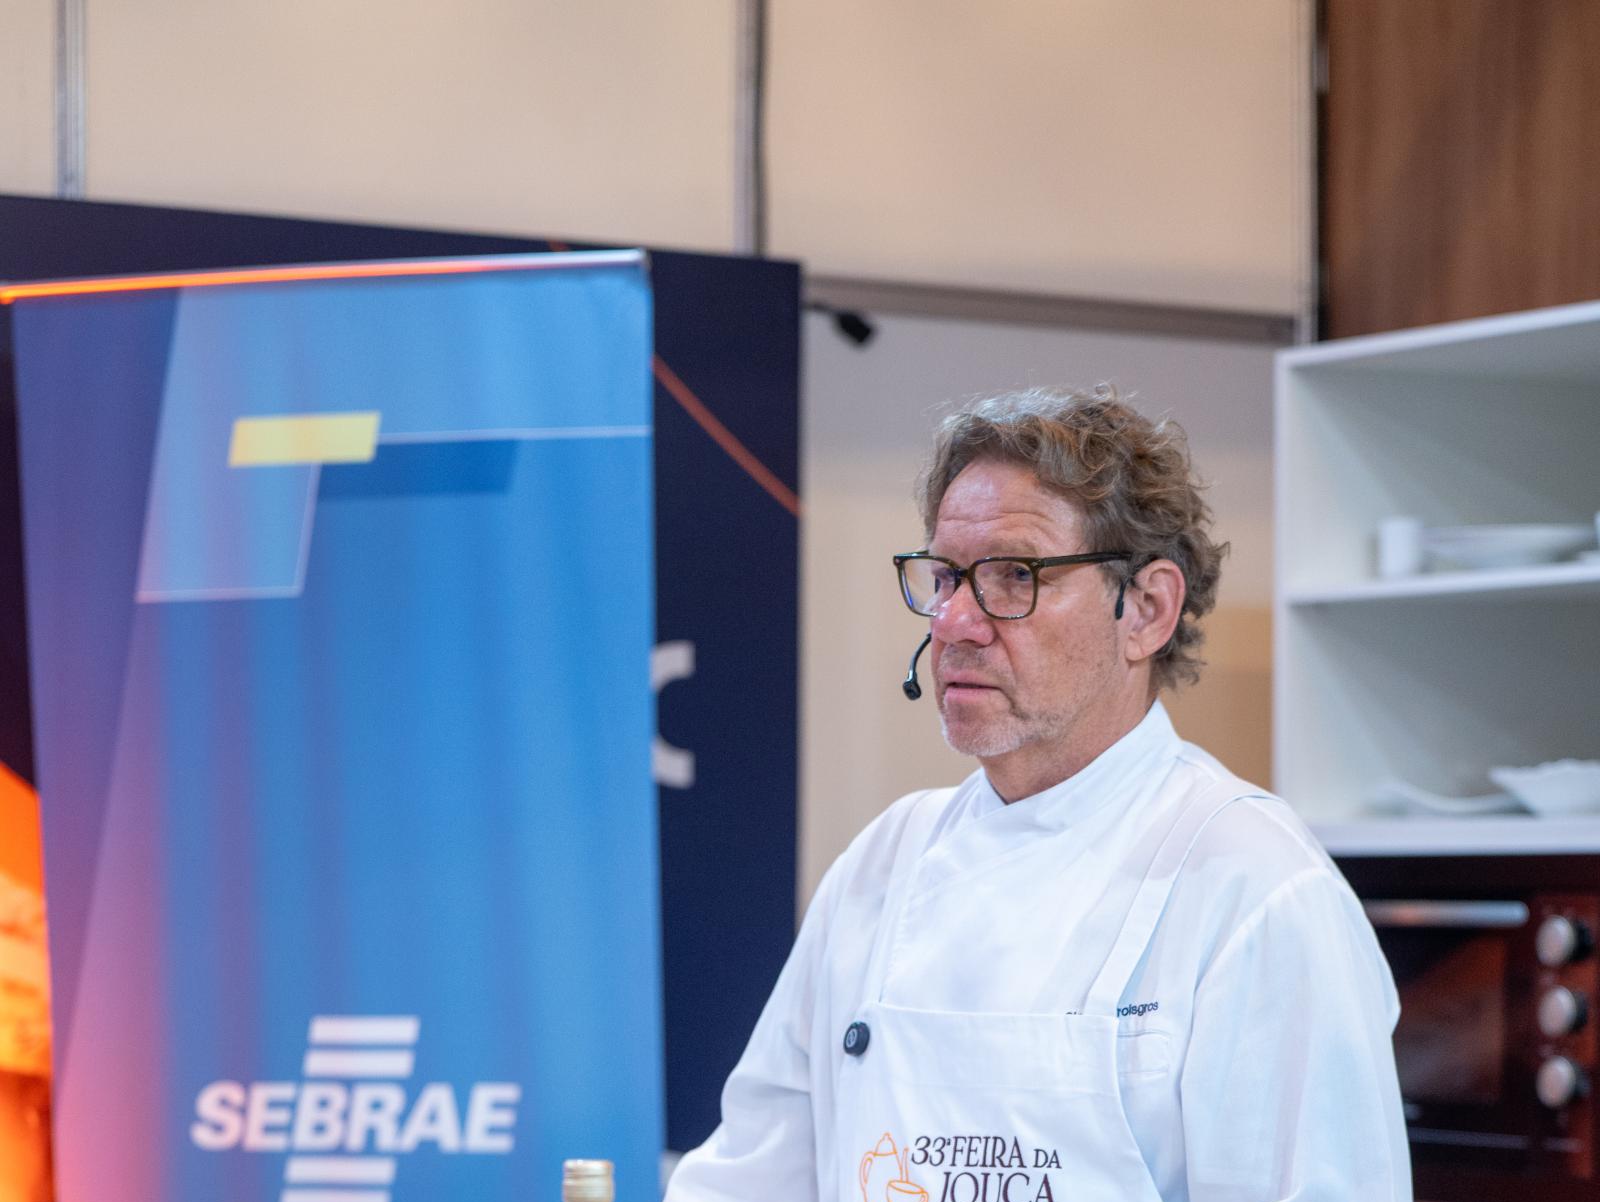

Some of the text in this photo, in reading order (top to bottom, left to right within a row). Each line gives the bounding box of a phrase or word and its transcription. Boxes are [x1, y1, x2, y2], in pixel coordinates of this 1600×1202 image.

[1116, 1001, 1159, 1018] roisgros
[190, 1080, 521, 1153] SEBRAE
[949, 1136, 1027, 1168] FEIRA
[1033, 1148, 1062, 1169] DA
